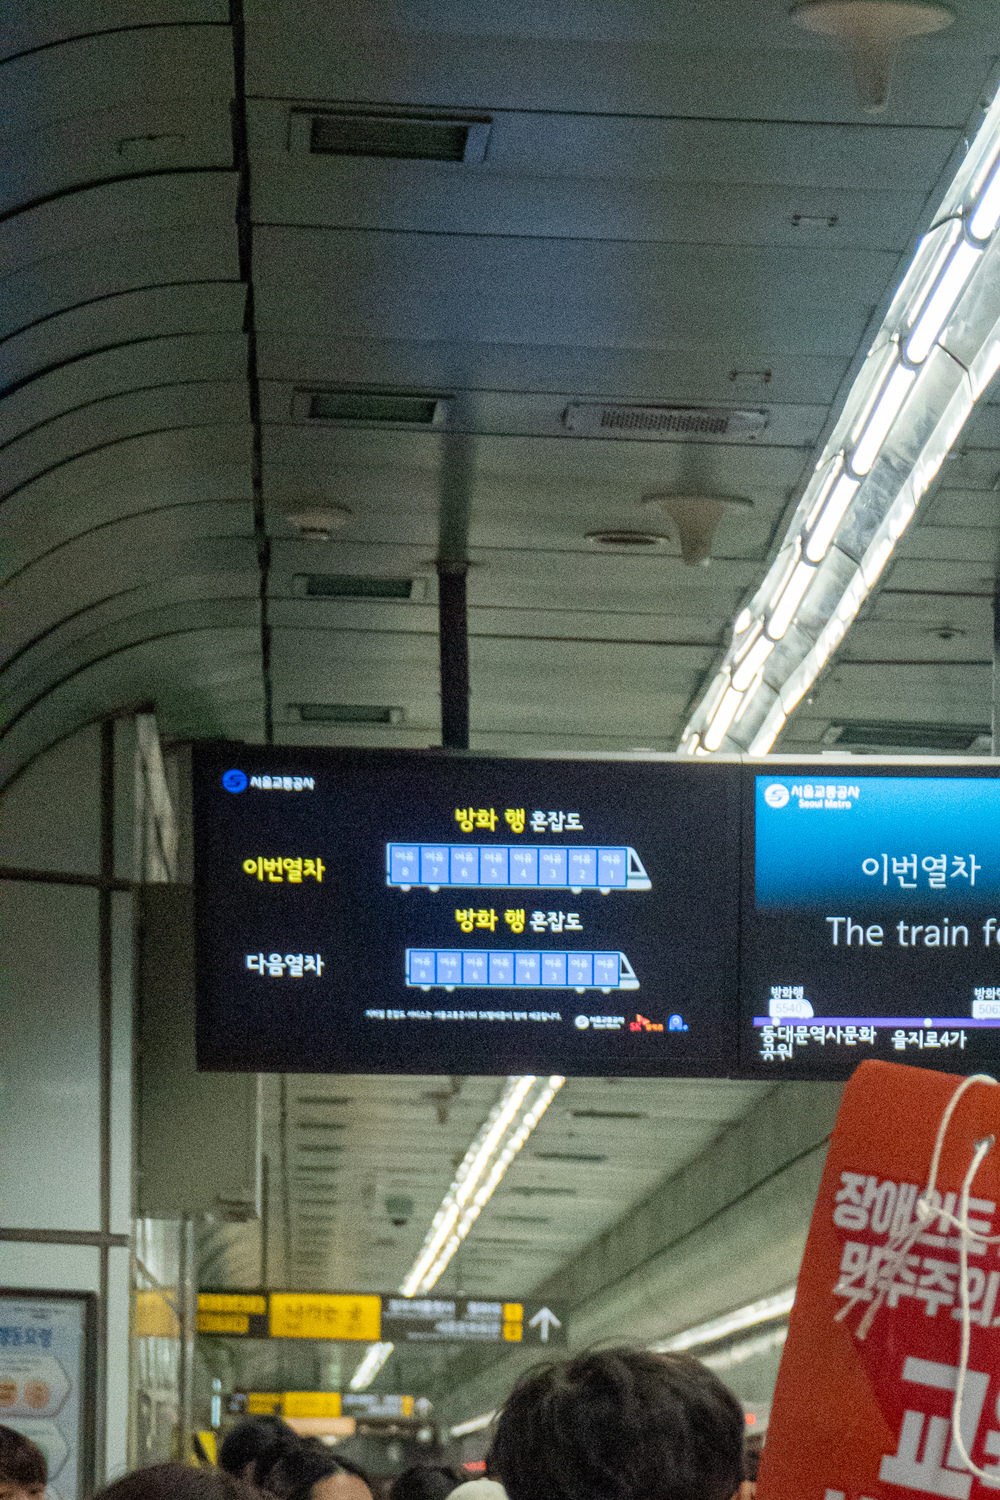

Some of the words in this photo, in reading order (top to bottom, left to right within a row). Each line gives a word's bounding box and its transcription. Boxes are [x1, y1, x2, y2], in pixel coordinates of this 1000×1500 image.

[250, 776, 315, 790] 서울교통공사
[791, 784, 860, 800] 서울교통공사
[799, 799, 823, 809] Seoul
[825, 799, 852, 810] Metro
[455, 808, 498, 832] 방화
[504, 808, 525, 833] 행
[530, 810, 583, 832] 혼잡도
[243, 856, 326, 883] 이번열차
[402, 866, 409, 876] 8
[432, 867, 438, 877] 7
[461, 867, 468, 877] 6
[491, 868, 497, 878] 5
[521, 869, 527, 878] 4
[550, 869, 556, 879] 3
[579, 869, 585, 879] 2
[609, 870, 614, 880] 1
[861, 853, 981, 888] 이번열차
[455, 909, 498, 932] 방화
[504, 909, 525, 933] 행
[530, 911, 583, 932] 혼잡도
[826, 917, 884, 946] The
[897, 917, 969, 946] train
[246, 953, 325, 977] 다음열차
[771, 986, 803, 999] 방화행
[775, 1003, 802, 1015] 5540
[760, 1025, 876, 1045] 동대문역사문화
[892, 1029, 967, 1050] 을지로4가
[760, 1043, 793, 1060] 공원
